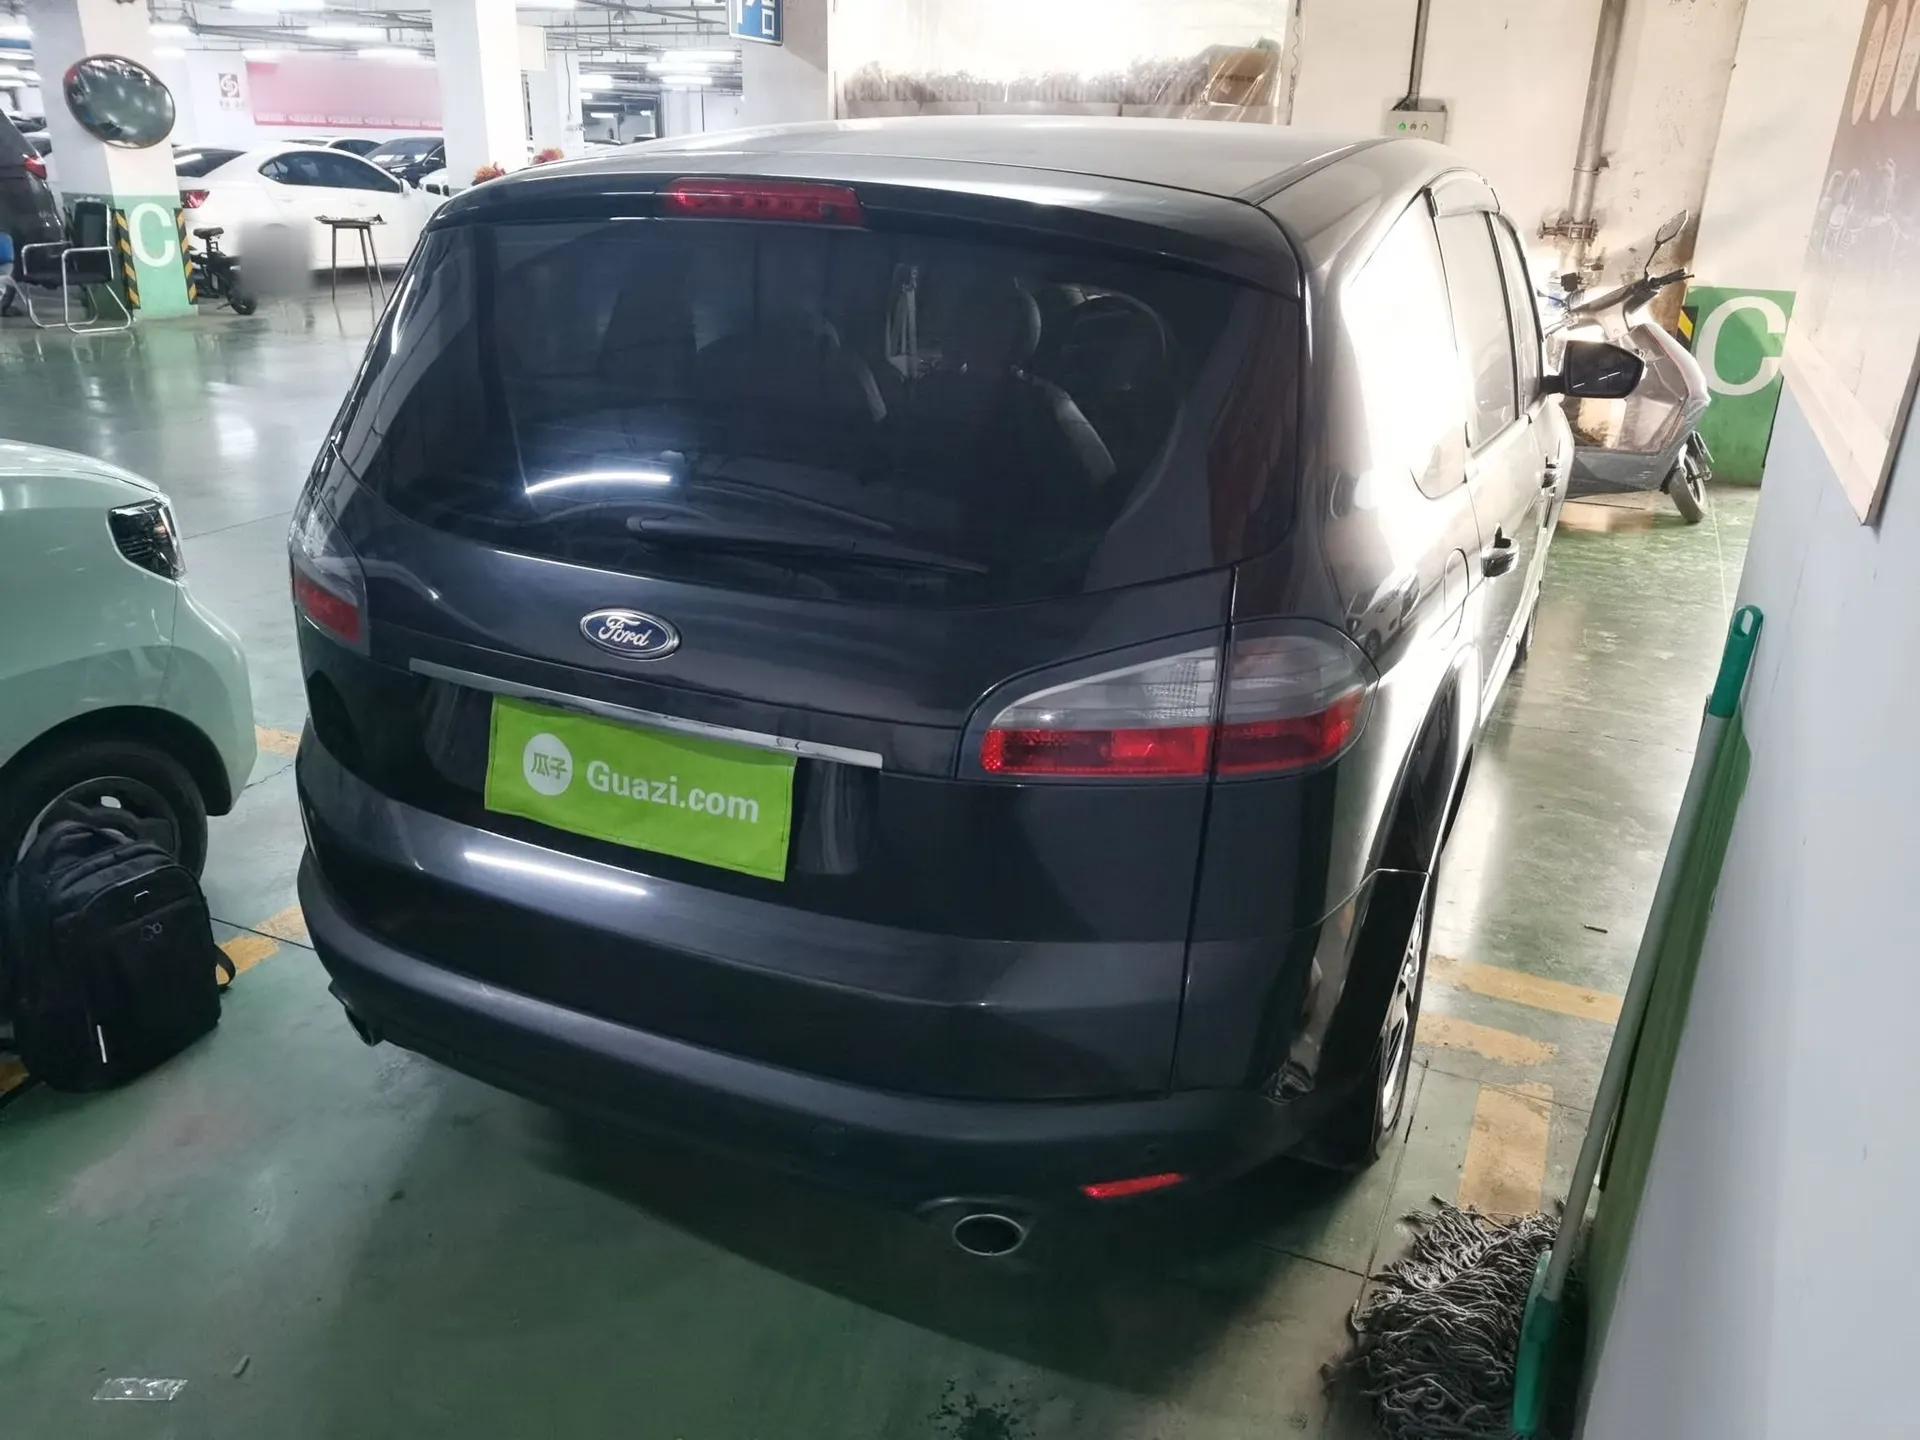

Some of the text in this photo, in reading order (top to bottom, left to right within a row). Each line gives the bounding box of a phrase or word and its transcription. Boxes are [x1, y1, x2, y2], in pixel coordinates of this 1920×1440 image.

[129, 203, 175, 267] C
[1696, 296, 1786, 395] C
[598, 615, 652, 647] Ford
[530, 752, 568, 780] 瓜子
[586, 760, 760, 823] Guazi.com
